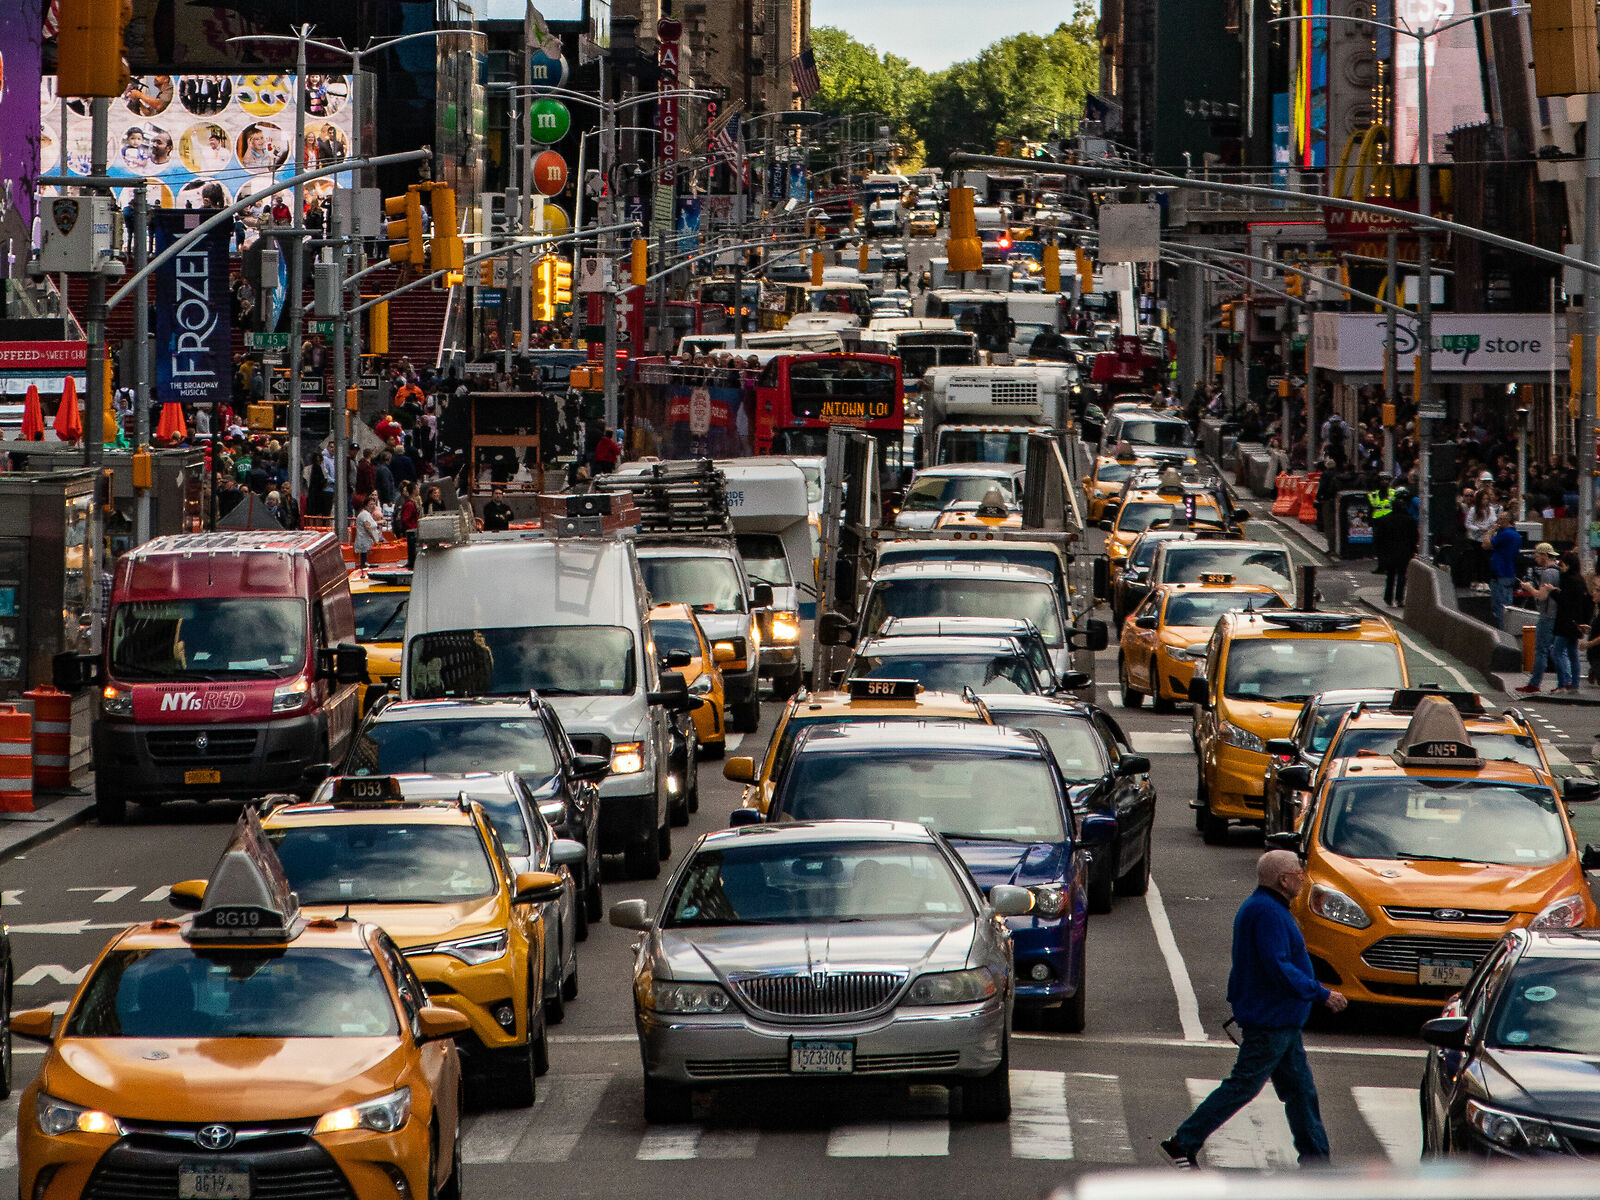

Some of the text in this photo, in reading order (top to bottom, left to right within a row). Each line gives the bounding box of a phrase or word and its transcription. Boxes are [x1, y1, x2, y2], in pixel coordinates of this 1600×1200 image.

[538, 113, 556, 128] m
[548, 166, 561, 181] m
[318, 322, 326, 331] W
[255, 336, 263, 345] W
[267, 335, 278, 345] 45
[1486, 337, 1541, 353] store
[71, 350, 86, 360] CHU
[868, 682, 896, 695] 5F87
[1427, 743, 1458, 757] 4N59
[351, 780, 382, 797] 1D53
[215, 911, 260, 926] 8G19
